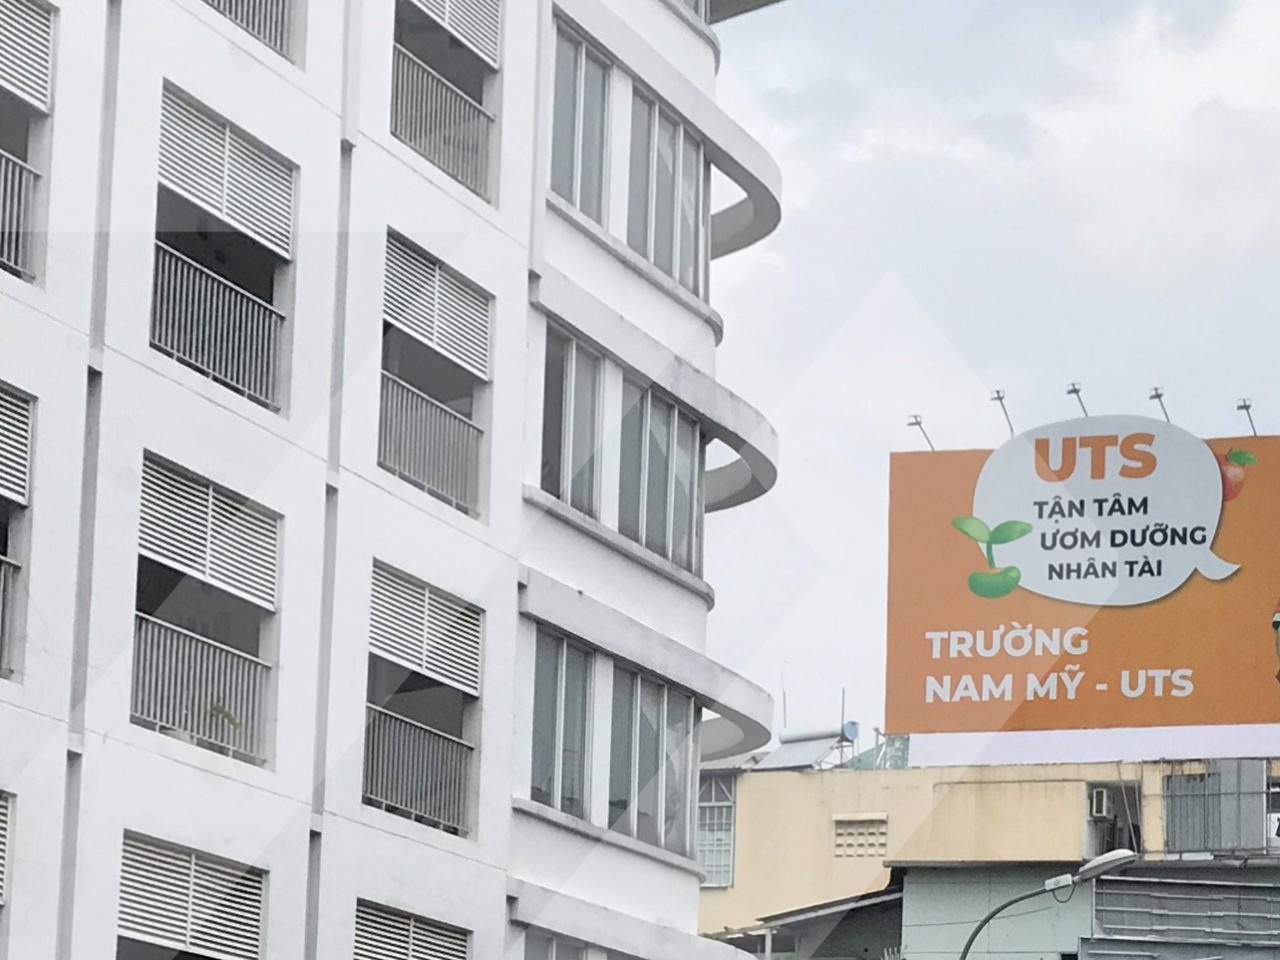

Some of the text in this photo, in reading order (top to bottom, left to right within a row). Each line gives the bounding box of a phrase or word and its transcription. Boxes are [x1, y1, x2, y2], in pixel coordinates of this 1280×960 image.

[1034, 432, 1158, 483] UTS
[1033, 492, 1148, 524] TẬN TÂM
[1040, 522, 1207, 551] ƯƠM DƯỠNG
[1048, 555, 1162, 580] NHÂN TÀI
[925, 622, 1088, 658] TRƯỜNG
[925, 664, 1194, 703] NAM MỸ - UTS
